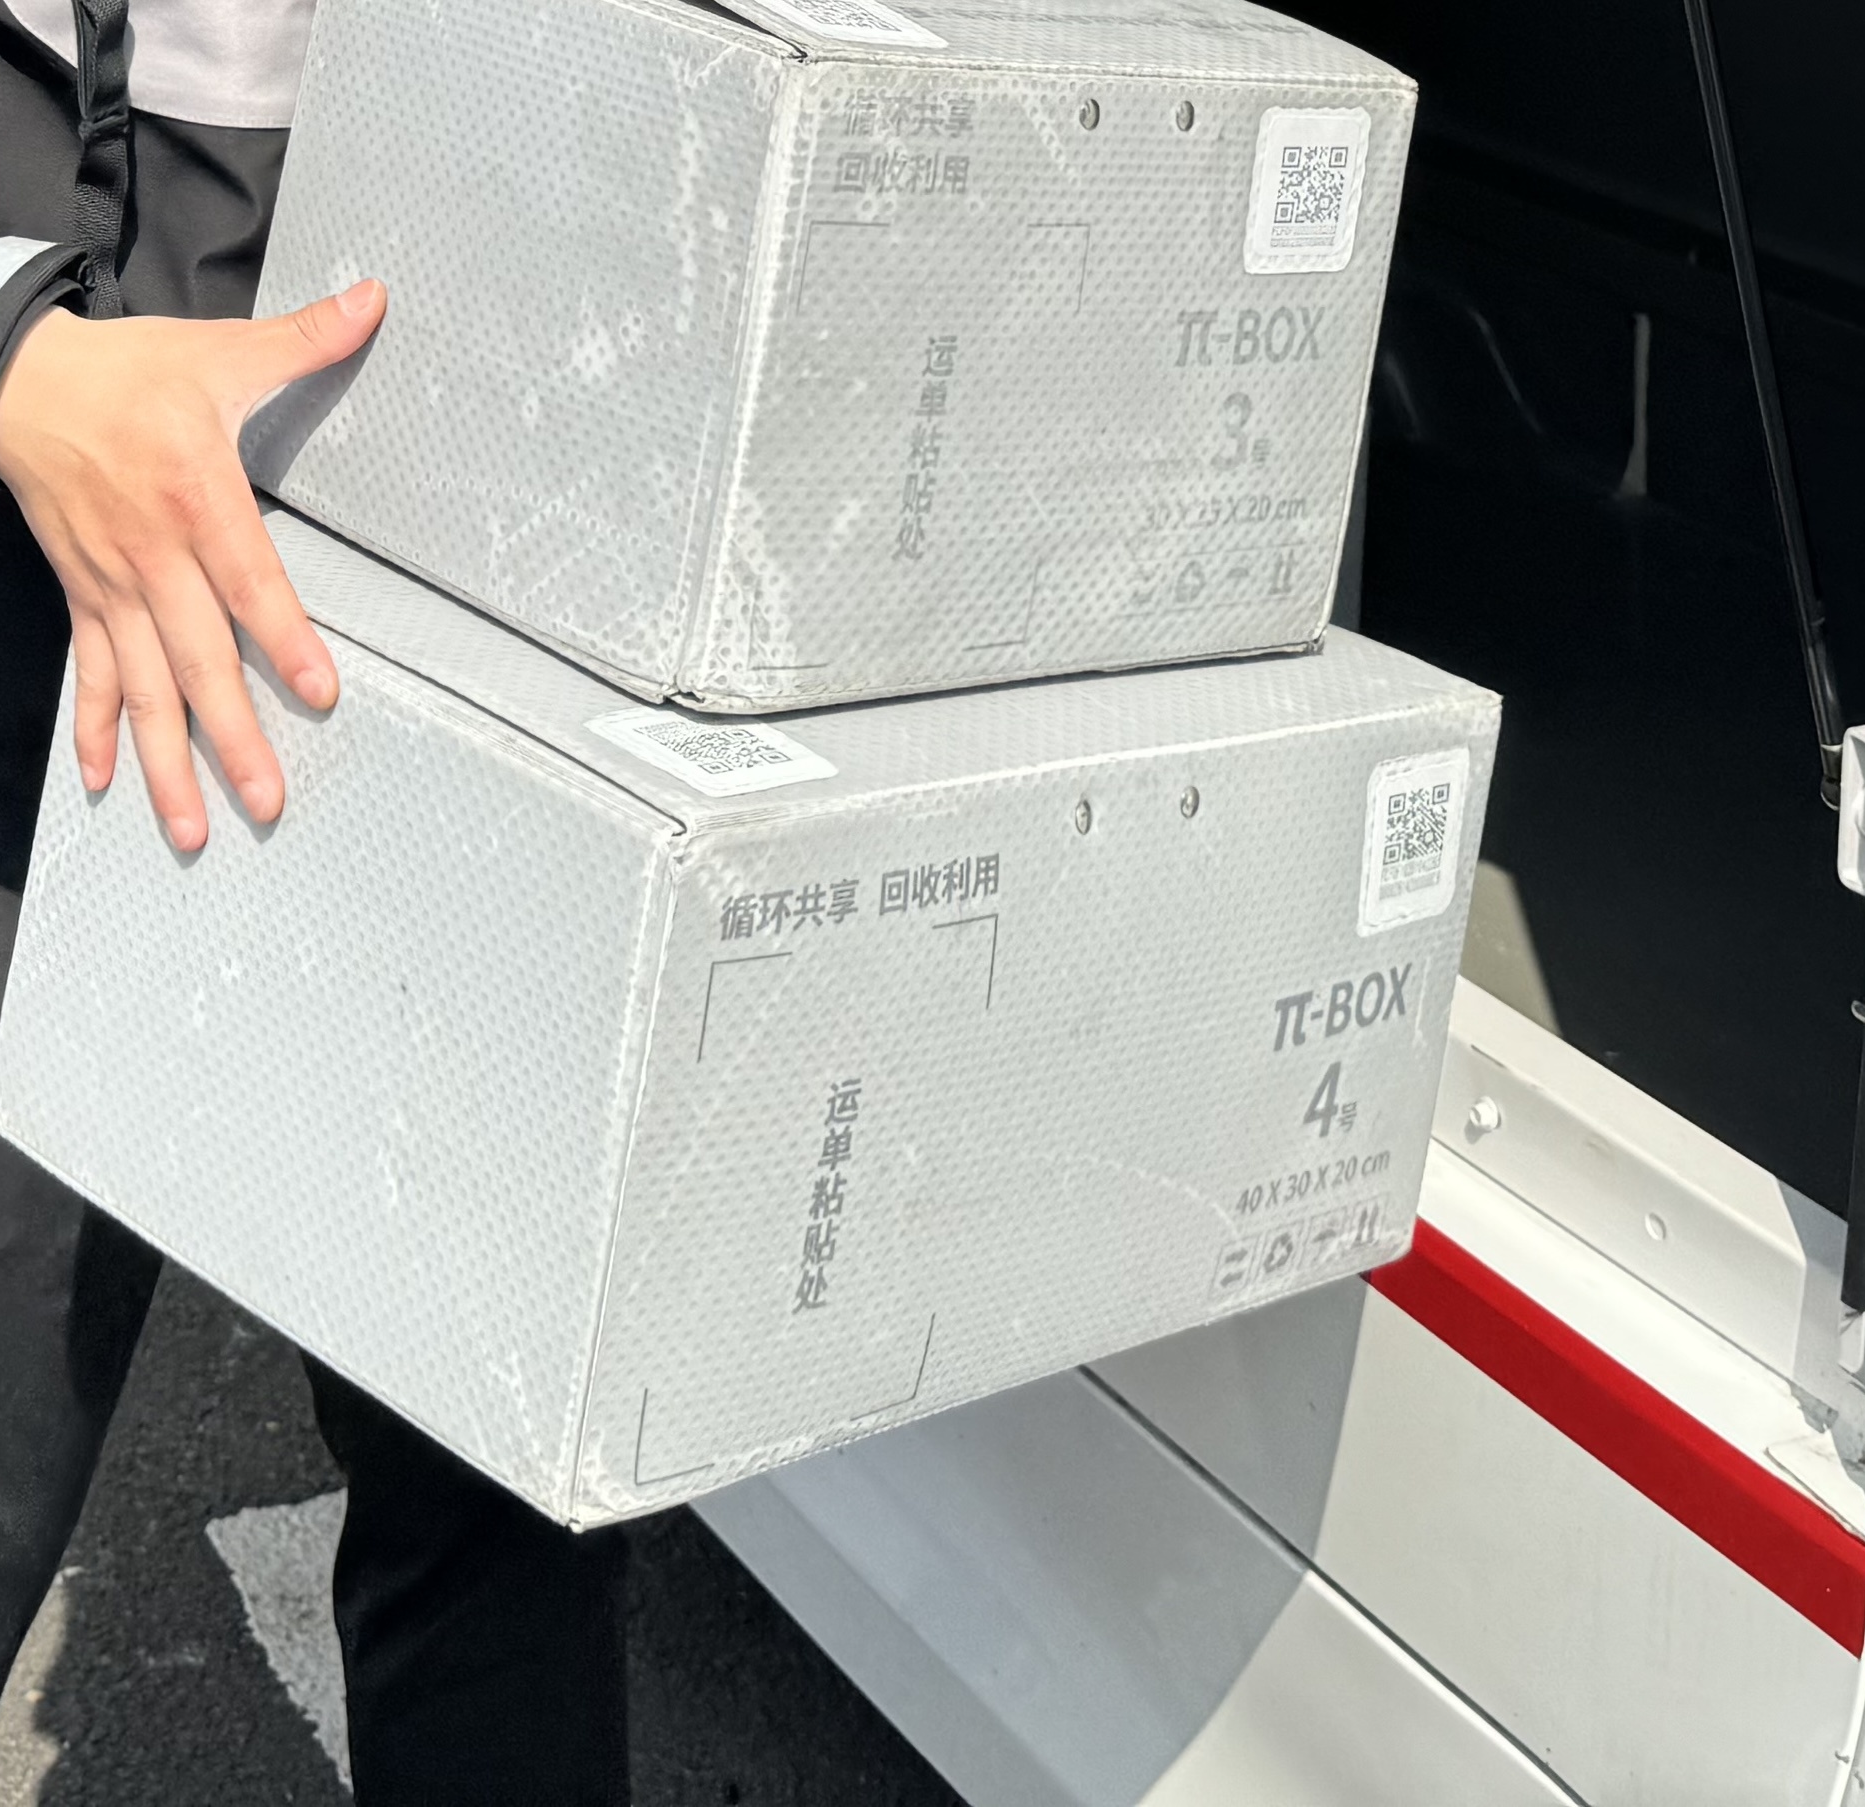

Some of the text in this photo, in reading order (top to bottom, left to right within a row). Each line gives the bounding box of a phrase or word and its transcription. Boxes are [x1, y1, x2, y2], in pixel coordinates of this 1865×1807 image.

[833, 150, 970, 196] 回收利用
[891, 336, 958, 561] 运单粘贴处
[719, 853, 999, 941] 循环共享 回收利用
[792, 1078, 862, 1314] 运单粘贴处
[1236, 1185, 1263, 1215] 40
[1285, 1170, 1310, 1202] 30
[1331, 1155, 1357, 1186] 20
[1361, 1150, 1391, 1177] cm
